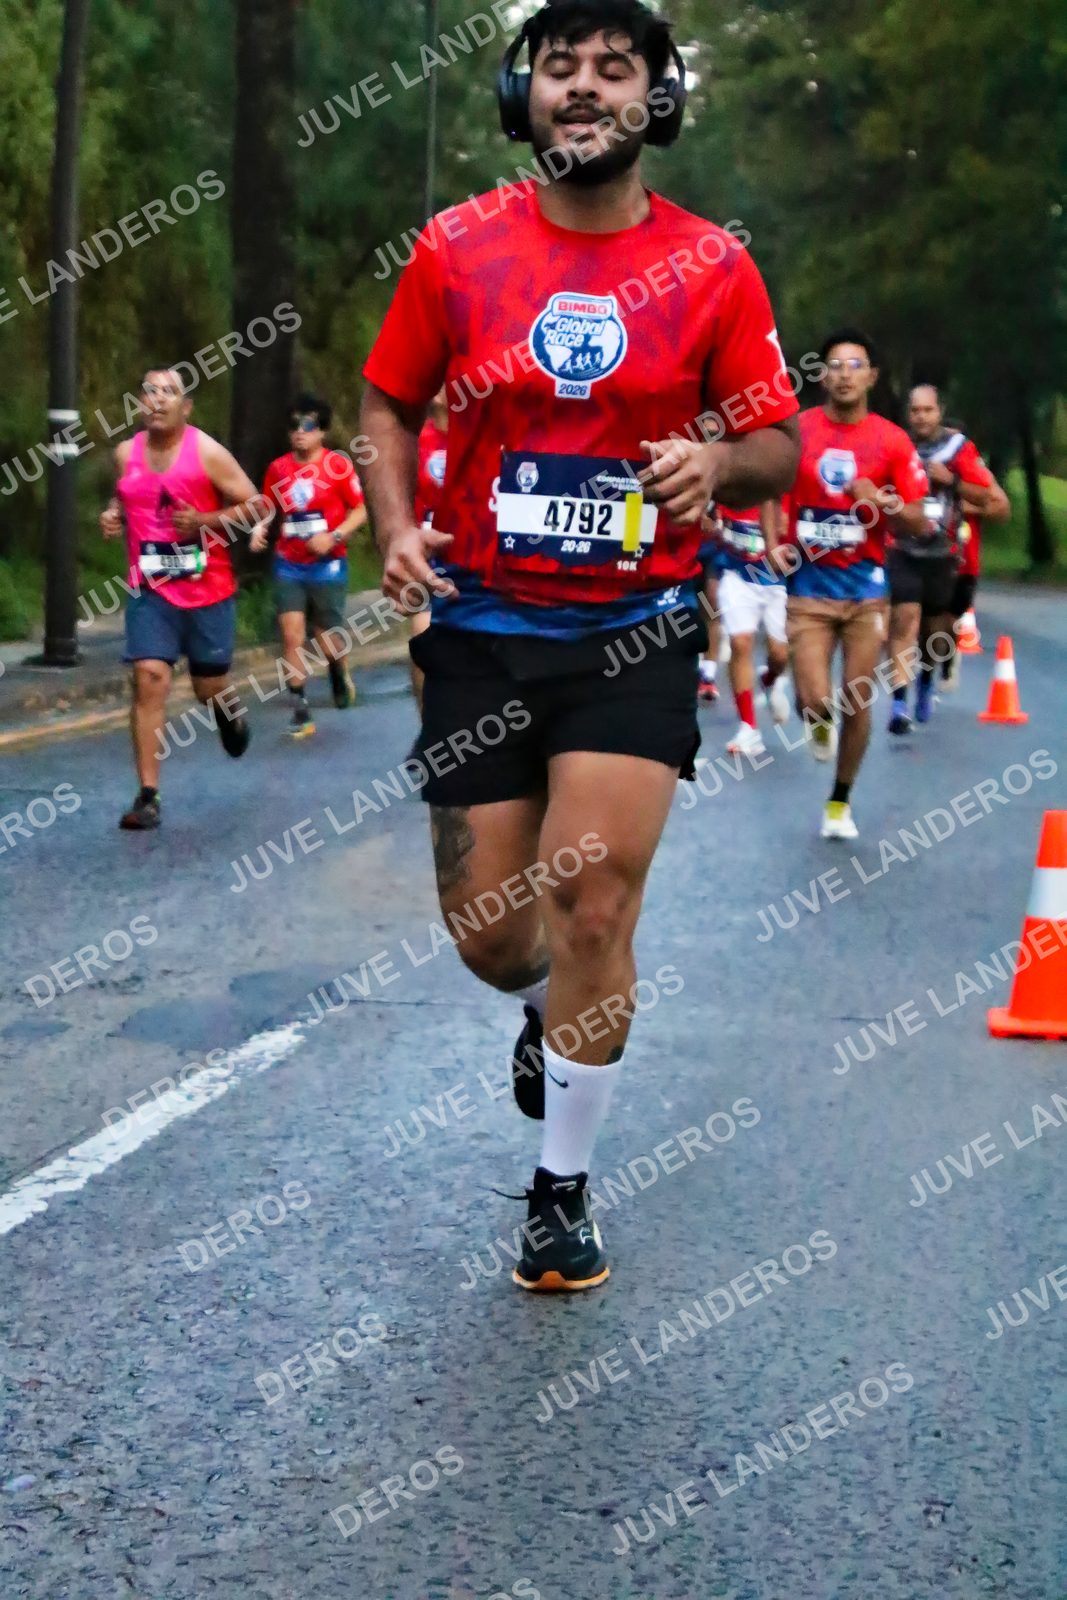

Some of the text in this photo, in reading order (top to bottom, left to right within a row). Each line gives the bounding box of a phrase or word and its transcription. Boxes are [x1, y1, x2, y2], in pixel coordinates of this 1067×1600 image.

[558, 301, 608, 314] BIMBO
[555, 318, 606, 335] Global
[544, 329, 585, 347] Race
[558, 384, 588, 396] 2026
[544, 500, 613, 536] 4792
[617, 560, 638, 571] 10K
